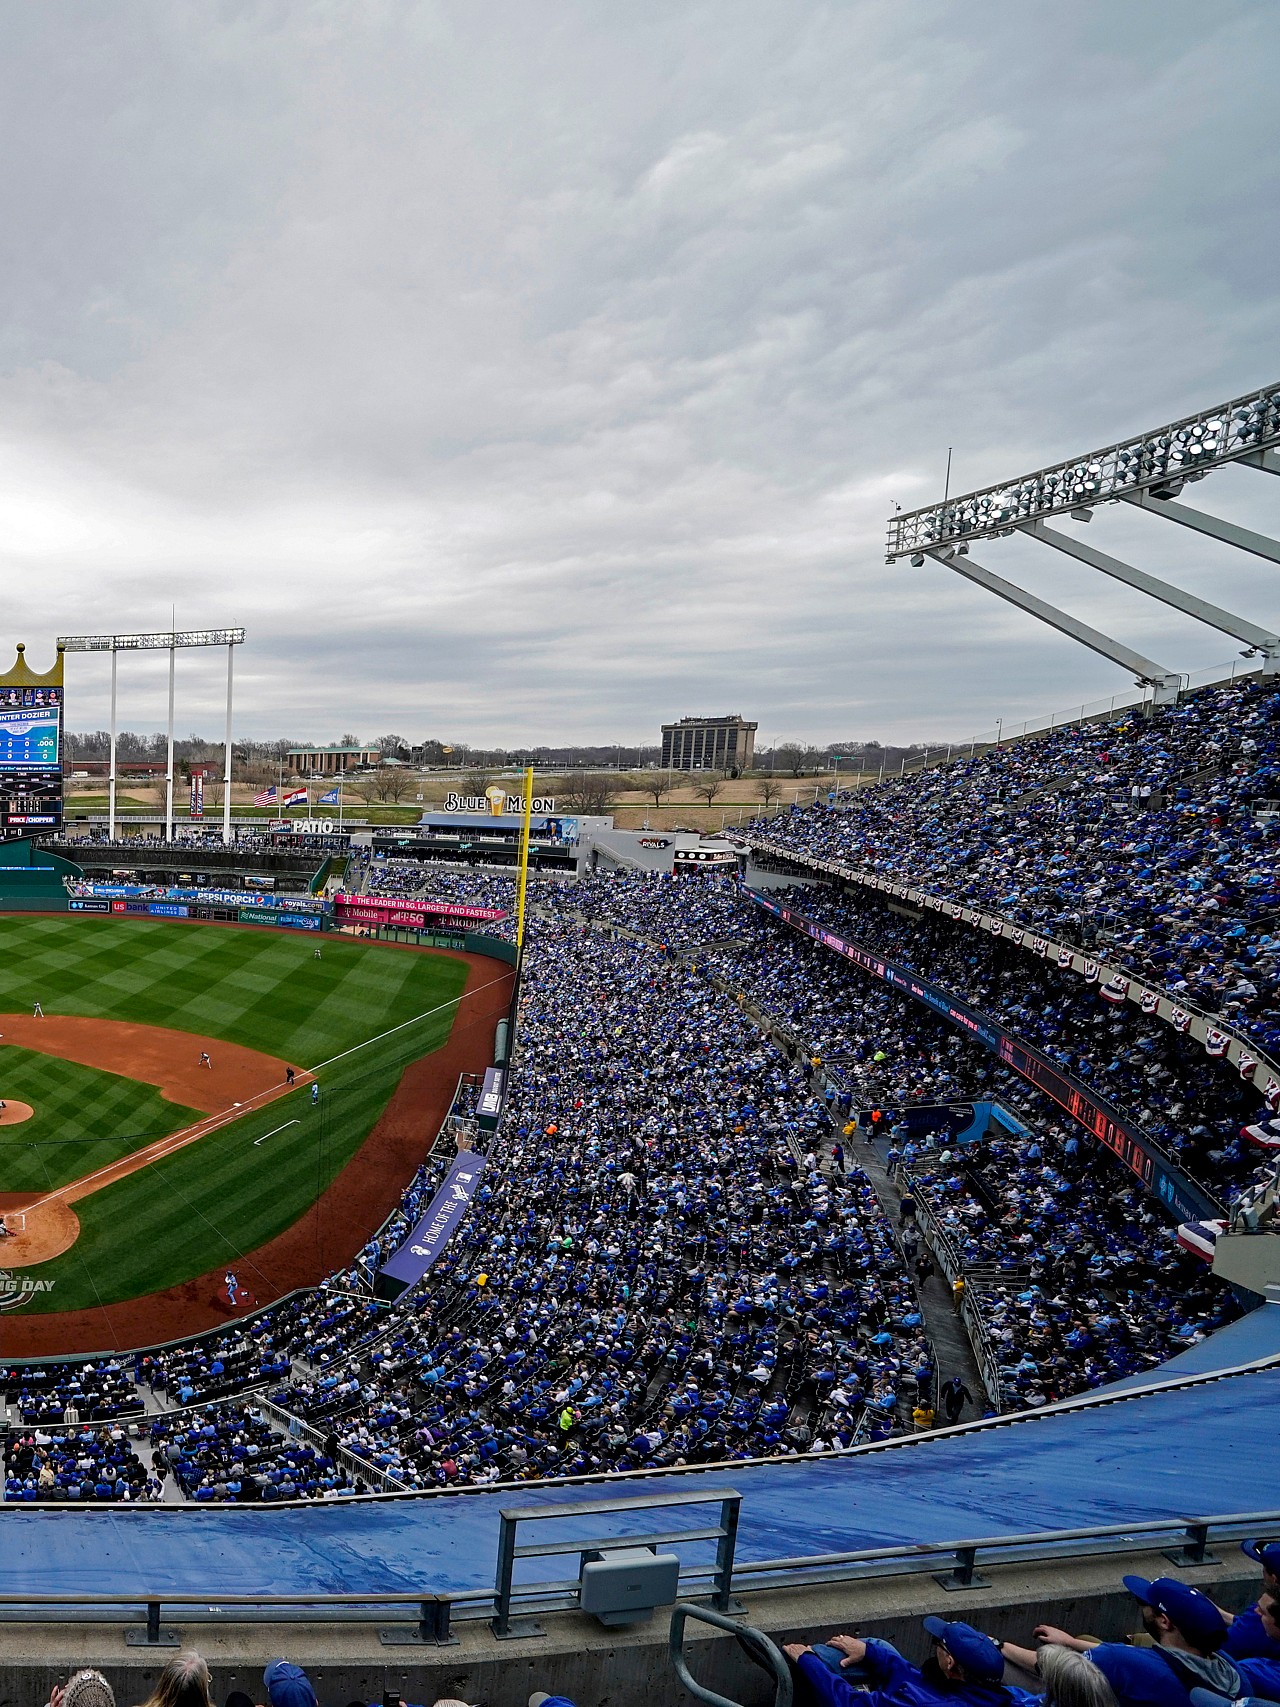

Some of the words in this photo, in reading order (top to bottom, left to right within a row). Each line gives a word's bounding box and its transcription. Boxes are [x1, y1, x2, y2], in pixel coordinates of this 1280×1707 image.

[446, 794, 486, 812] BLUE
[294, 821, 334, 834] PATIO
[198, 892, 223, 901] PEPSI
[224, 894, 254, 904] PORCH
[126, 902, 148, 911] bank
[285, 900, 323, 909] royals.com
[371, 898, 396, 908] LEADER
[418, 903, 448, 913] LARGEST
[449, 906, 464, 915] AND
[465, 908, 497, 918] FASTEST.
[249, 913, 277, 921] National
[352, 908, 378, 919] Mobile
[410, 912, 424, 924] 5G
[449, 916, 480, 929] Mobil
[482, 1093, 498, 1112] UMB
[440, 1200, 458, 1214] THE
[435, 1213, 450, 1223] OF
[422, 1222, 444, 1244] HOME
[21, 1280, 56, 1292] DAY
